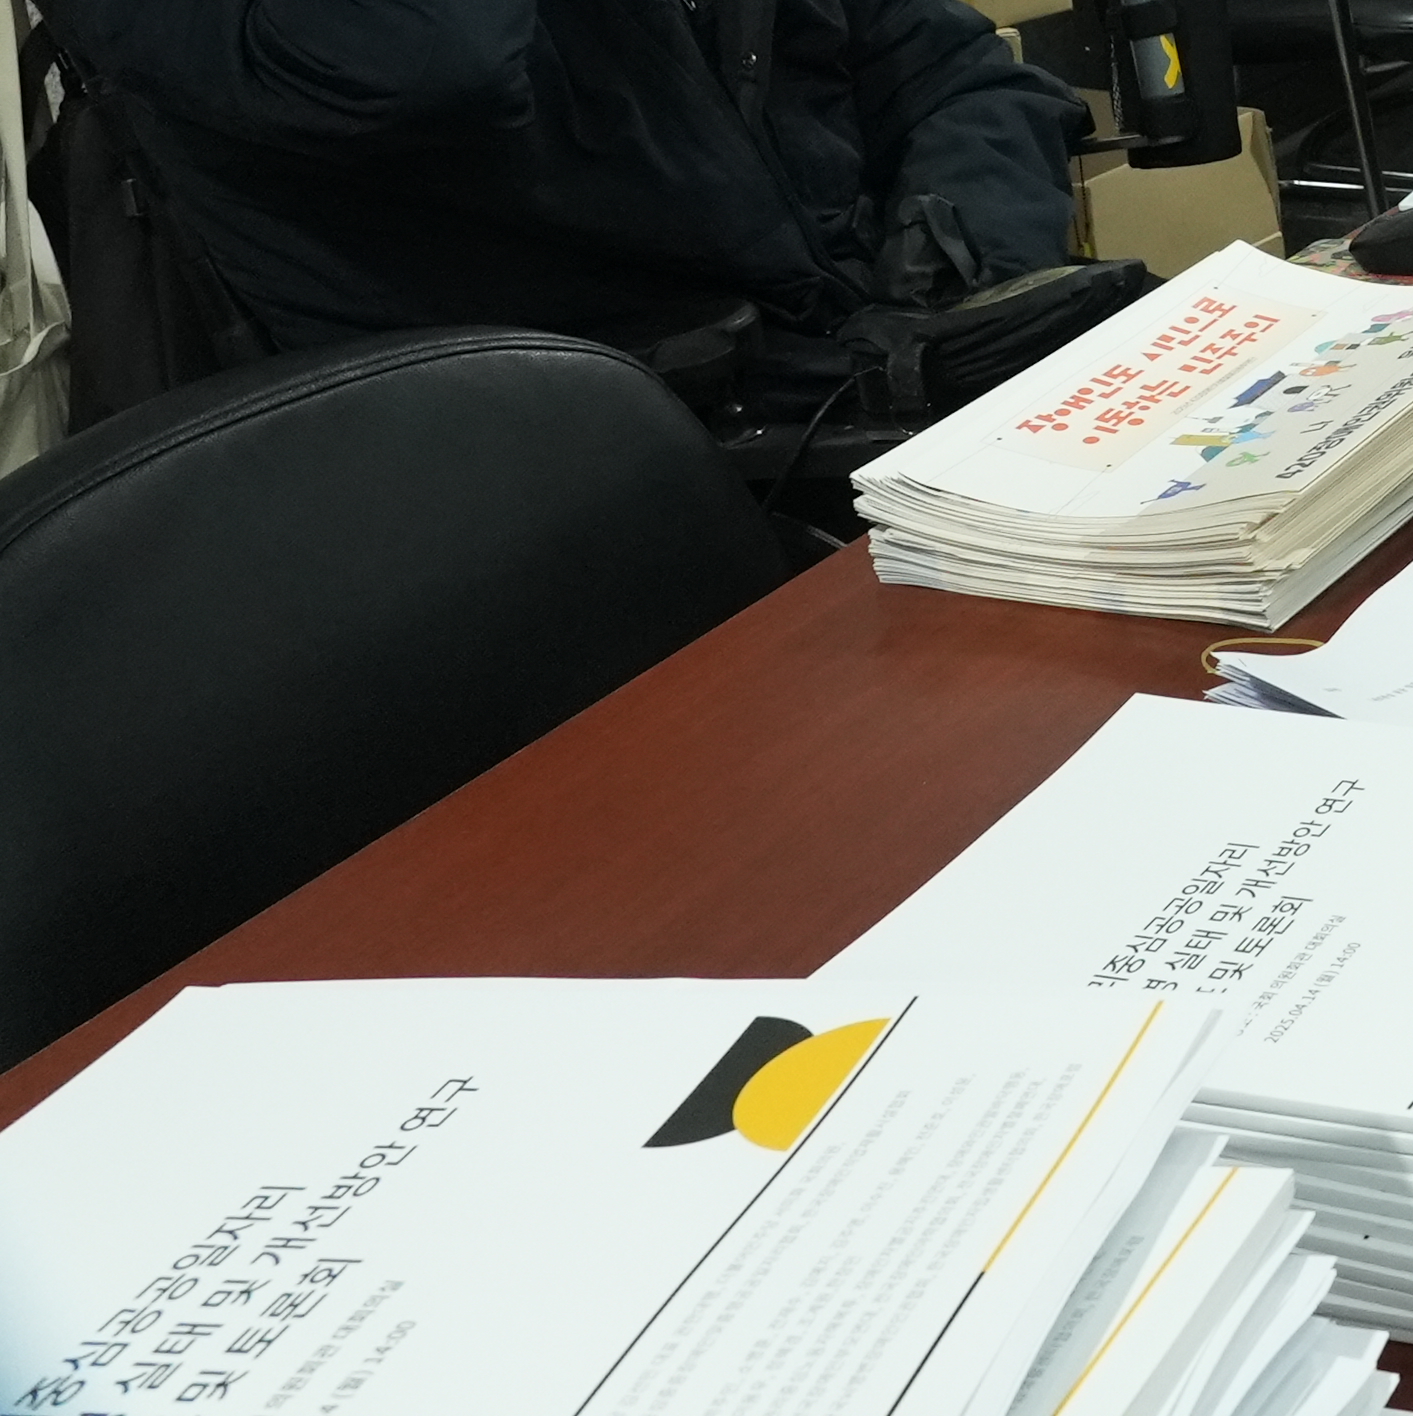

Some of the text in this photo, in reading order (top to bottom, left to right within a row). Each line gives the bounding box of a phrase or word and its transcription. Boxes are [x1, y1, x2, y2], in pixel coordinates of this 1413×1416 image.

[1015, 363, 1145, 434] 장애인도
[1141, 296, 1238, 362] 시민으로
[1082, 379, 1192, 445] 이동하는
[1177, 313, 1281, 375] 민주주의
[1301, 419, 1334, 435] 나
[1165, 928, 1228, 970] 실태
[1208, 903, 1253, 923] 및
[1235, 820, 1332, 898] 개선방안
[1314, 779, 1365, 815] 연구
[1208, 960, 1254, 980] 및
[1234, 895, 1314, 958] 토론회
[1337, 941, 1362, 971] 14:00
[116, 1075, 480, 1395] 실태 및 개선방안 연구
[175, 1258, 364, 1403] 및 토론회
